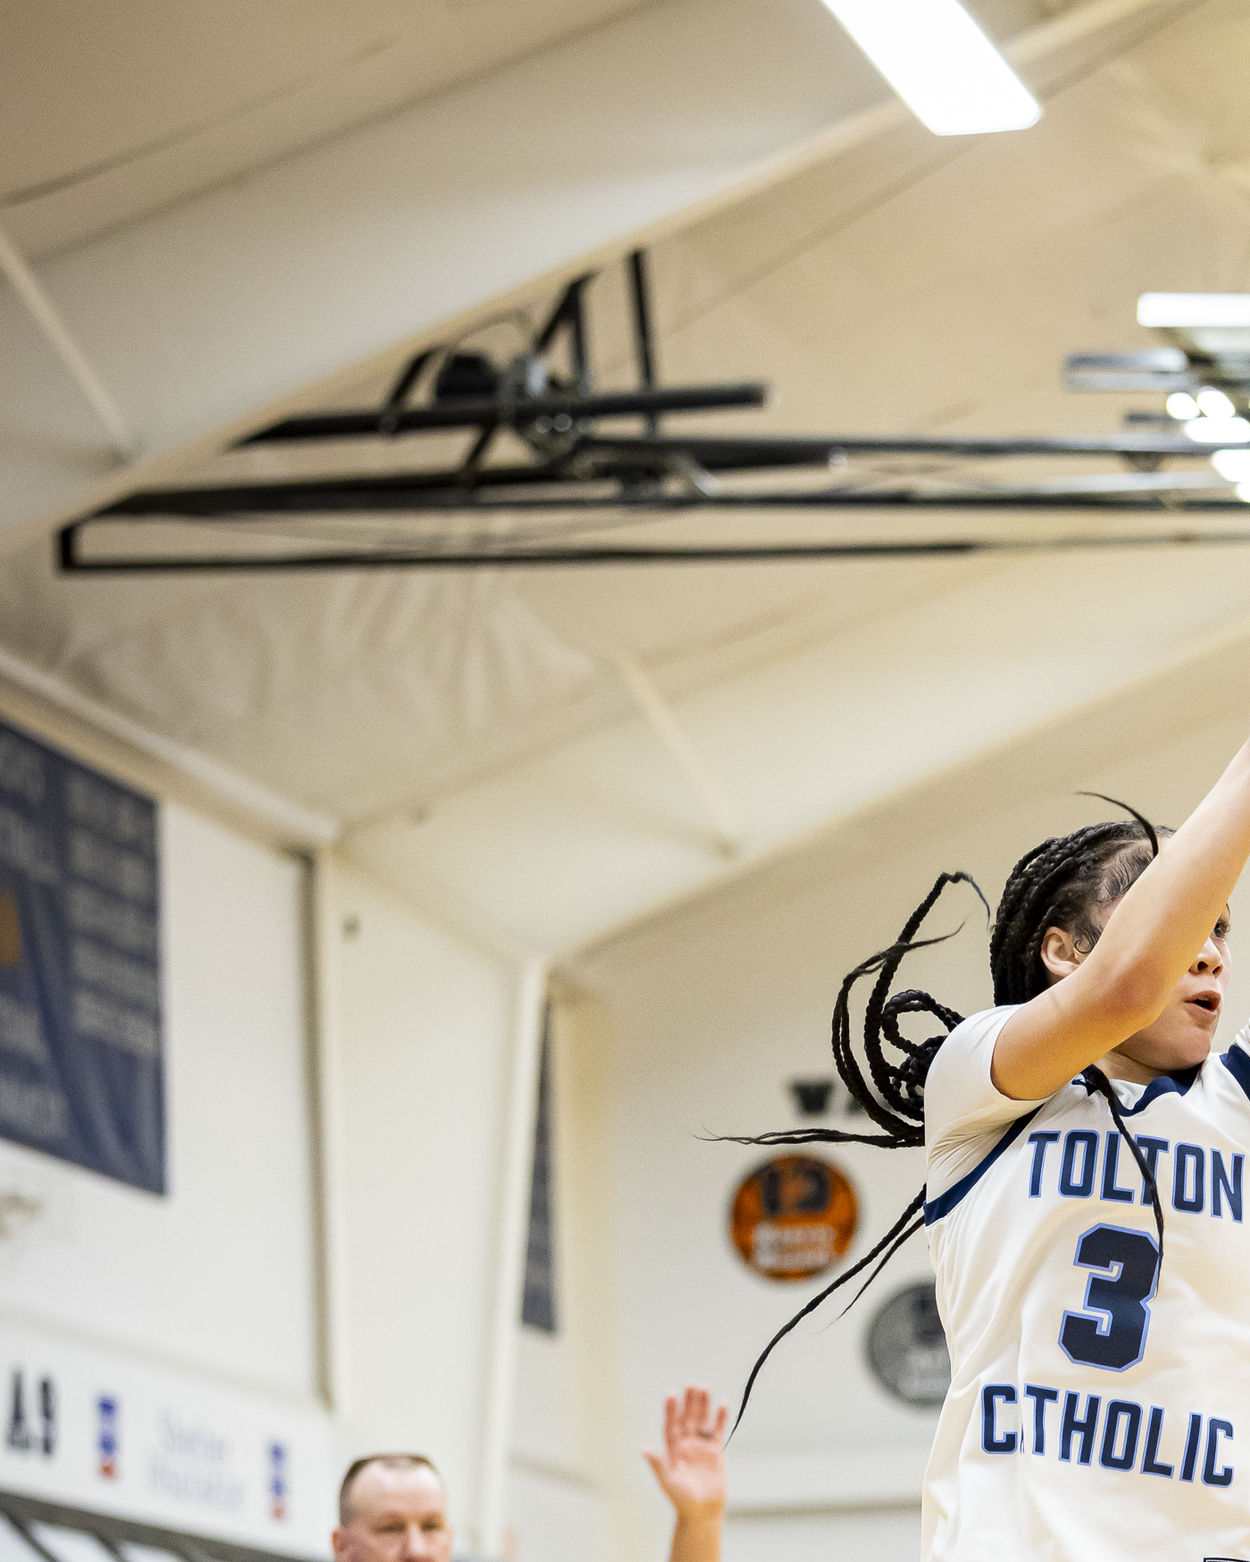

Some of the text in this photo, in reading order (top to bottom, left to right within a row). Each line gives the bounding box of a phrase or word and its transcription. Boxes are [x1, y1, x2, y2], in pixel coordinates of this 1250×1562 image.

[1026, 1129, 1246, 1224] TOLTON
[1057, 1221, 1161, 1373] 3
[981, 1383, 1235, 1488] CTHOLIC
